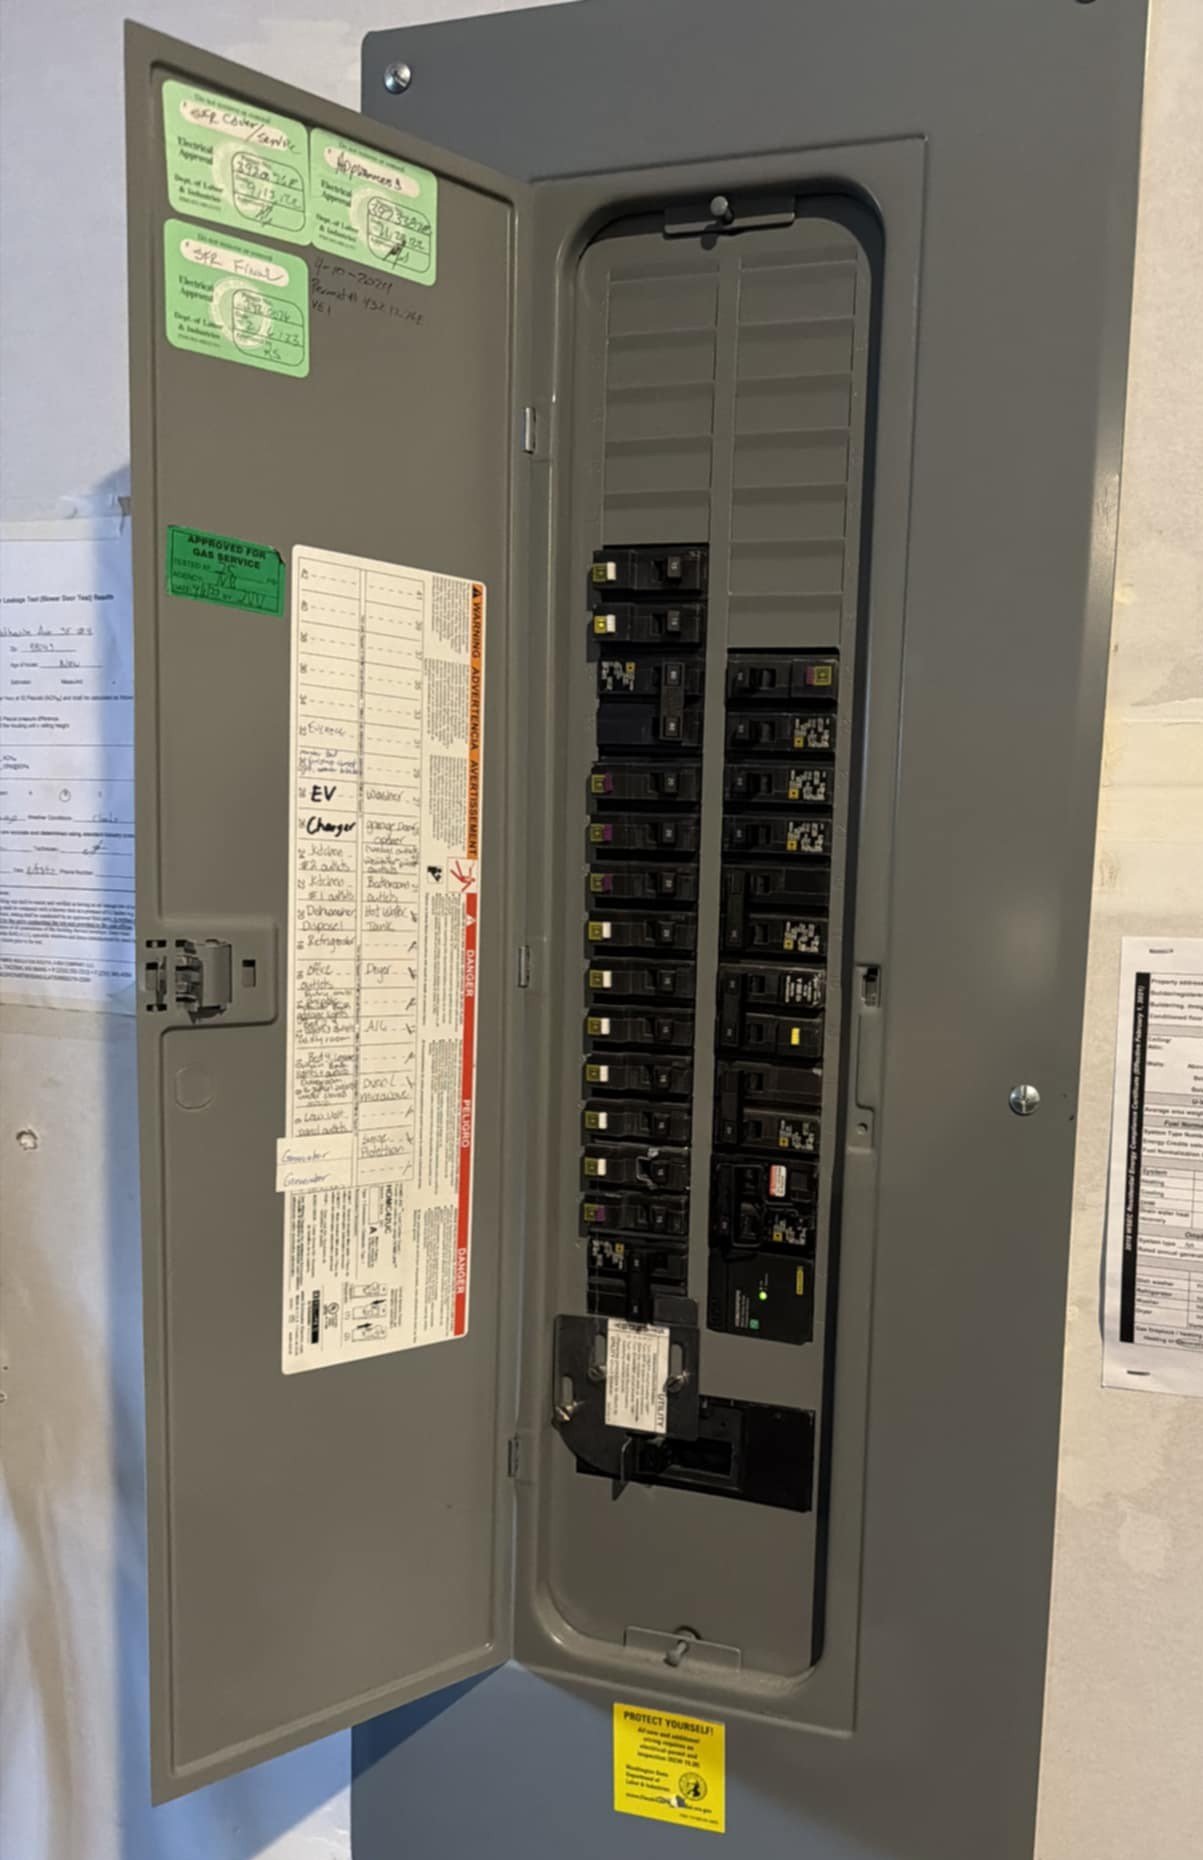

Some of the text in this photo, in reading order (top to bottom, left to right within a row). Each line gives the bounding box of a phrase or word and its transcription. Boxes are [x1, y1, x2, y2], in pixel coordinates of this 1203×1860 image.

[178, 137, 213, 154] Electrical
[321, 179, 352, 197] Electrical
[179, 275, 213, 291] Electrical
[188, 535, 266, 560] APPROVED FOR
[193, 548, 260, 569] GAS SERVICE
[472, 601, 482, 659] WARNING
[470, 666, 481, 750] ADVERTENCIA
[311, 785, 336, 802] EV
[468, 759, 479, 856] AVERTISSEMENT
[306, 816, 357, 837] Charger
[466, 950, 476, 997] DANGER
[461, 1099, 470, 1148] PELIGRO
[456, 1247, 466, 1294] DANGER
[657, 1393, 665, 1428] UTILITY
[624, 1711, 713, 1736] PROTECT YOURSELF!
